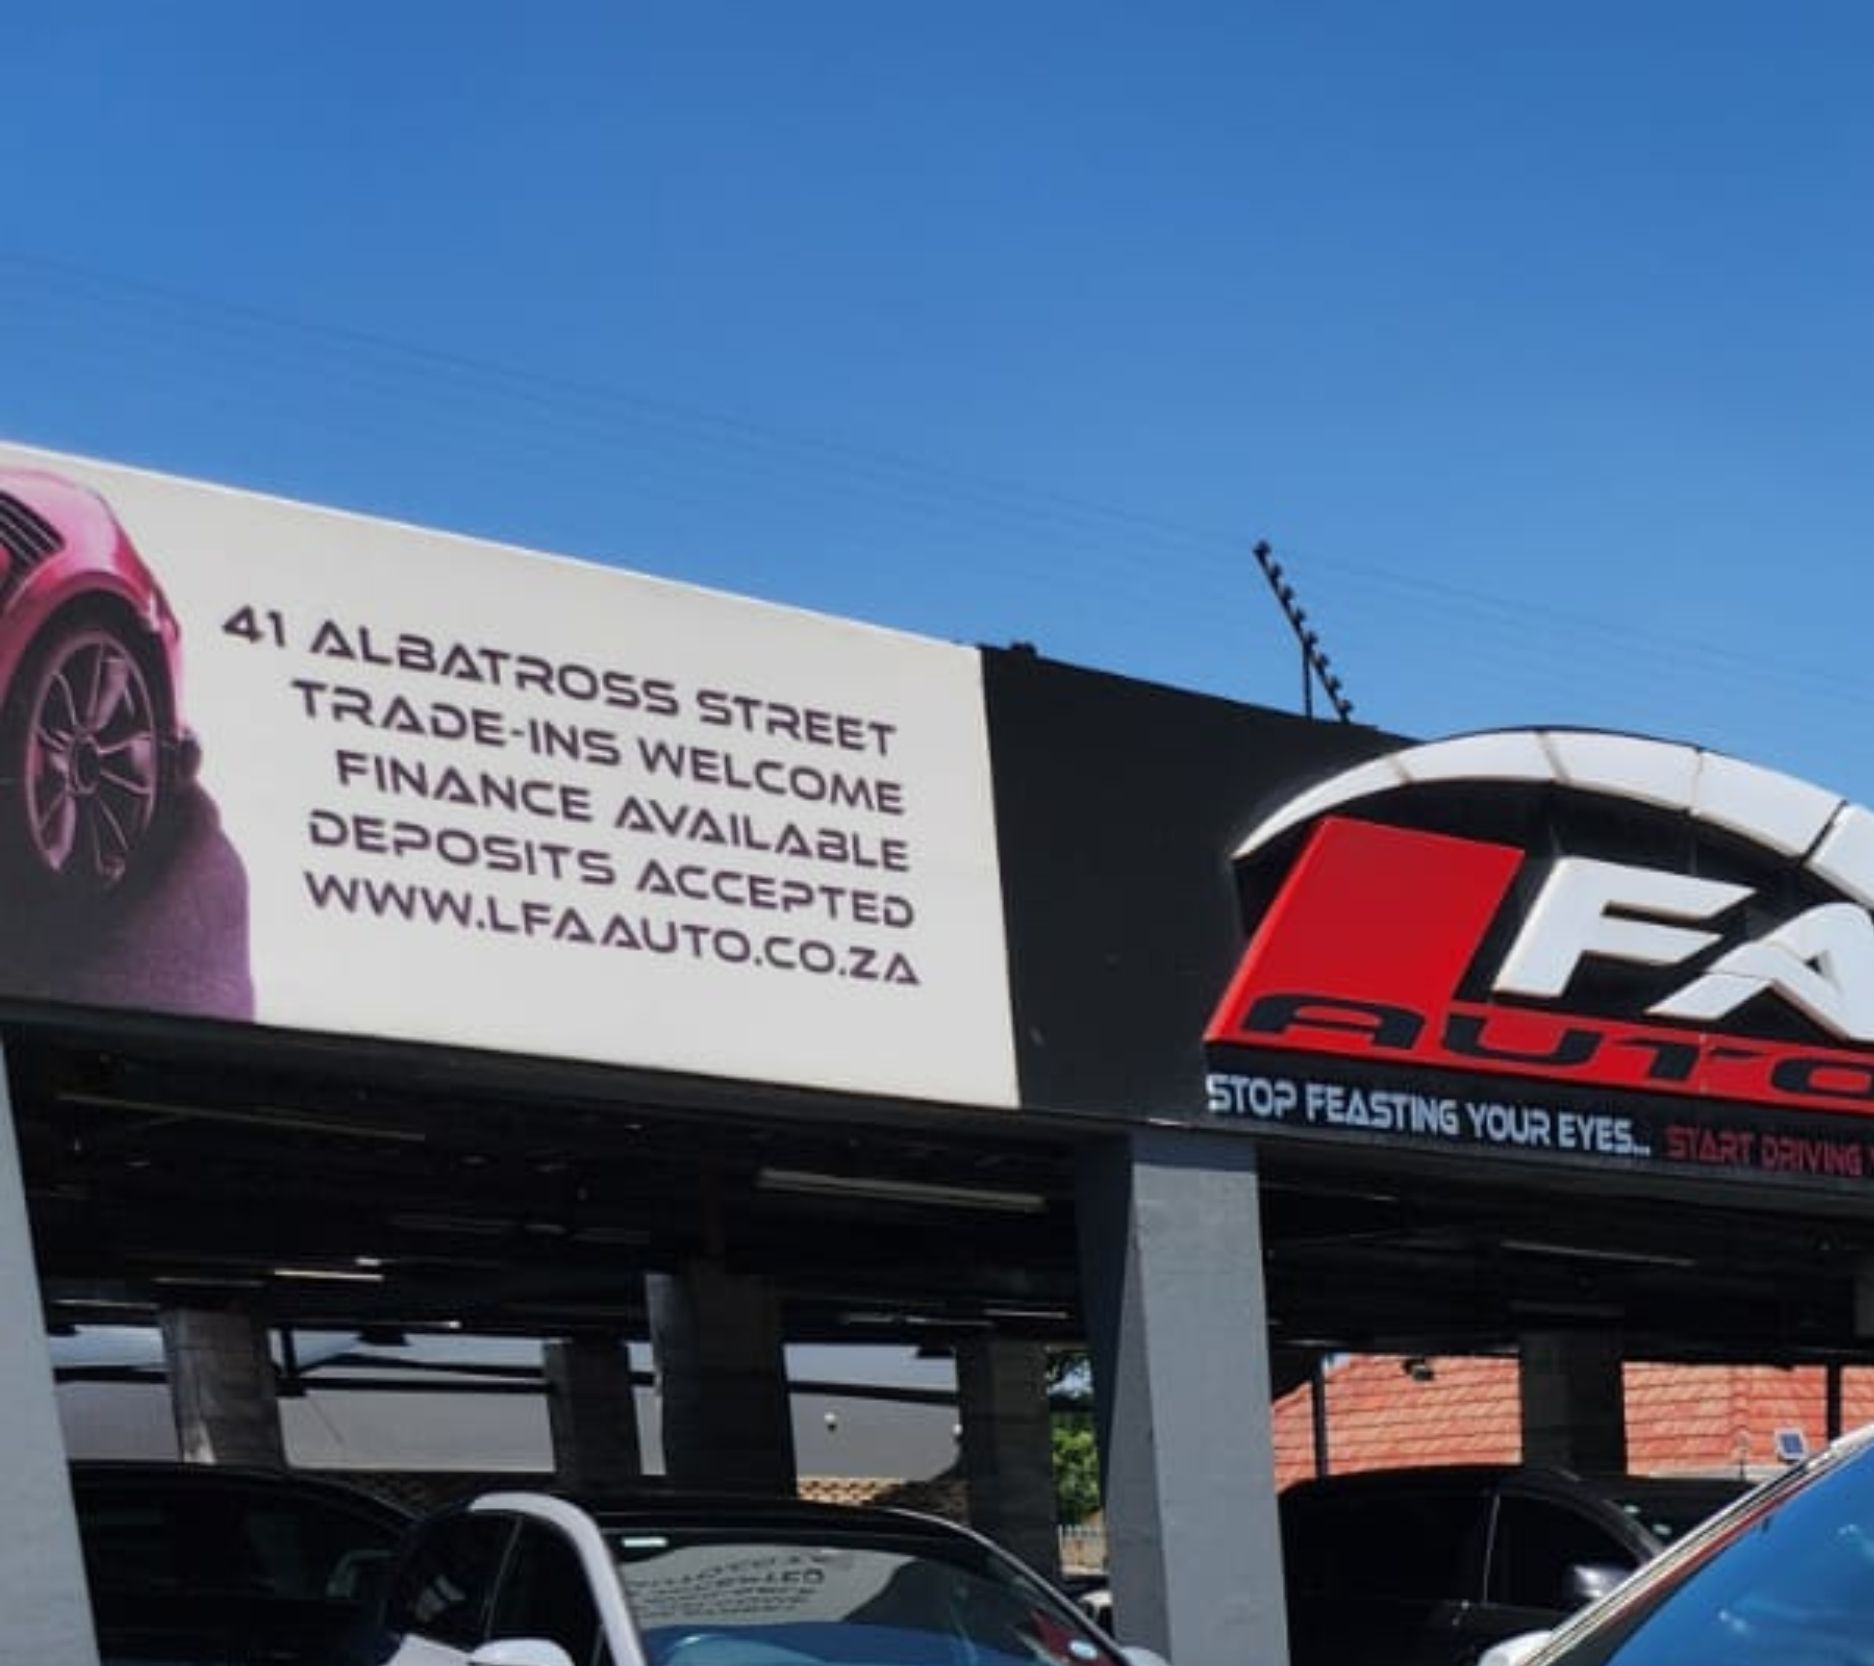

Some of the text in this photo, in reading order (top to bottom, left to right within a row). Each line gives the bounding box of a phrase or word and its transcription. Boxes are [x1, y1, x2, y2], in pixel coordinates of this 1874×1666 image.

[221, 605, 898, 757] 41 ALBATROSS STREET
[290, 678, 905, 816] TRADE-INS WELCOME
[308, 808, 915, 929] DEPOSITS ACCEPTED
[335, 749, 910, 873] FINANCE AVAILABLE
[303, 871, 921, 986] WWW.LFAAUTO.CO.ZA
[1206, 1073, 1298, 1117] STOP
[1305, 1083, 1459, 1136] FEASTING
[1466, 1104, 1551, 1148] YOUR
[1557, 1112, 1651, 1158] EYES...
[1664, 1125, 1754, 1165] START
[1761, 1135, 1864, 1177] DRIVING
